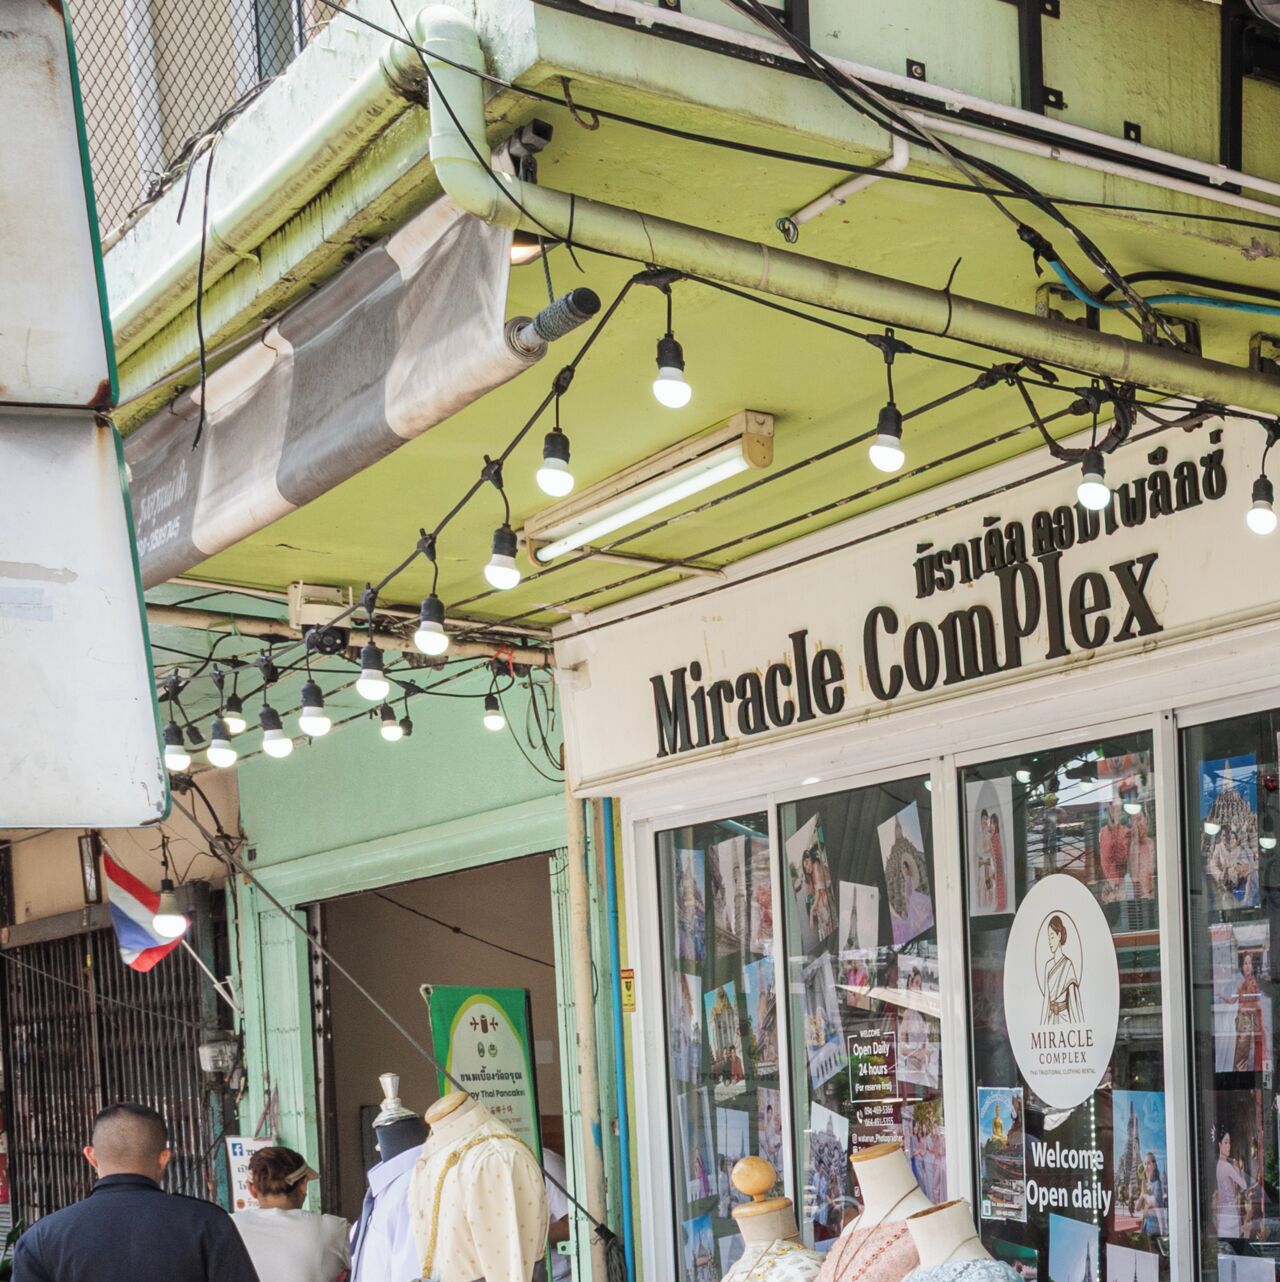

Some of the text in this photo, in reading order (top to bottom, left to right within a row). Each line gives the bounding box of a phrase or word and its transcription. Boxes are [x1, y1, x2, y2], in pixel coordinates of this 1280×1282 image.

[912, 516, 1029, 599] มิราเคิล
[649, 629, 847, 758] Miracle
[853, 1041, 890, 1059] Open Daily
[1031, 1029, 1094, 1050] MIRACLE
[1039, 1051, 1087, 1065] COMPLEX
[858, 1062, 888, 1076] 24 hours
[481, 1090, 495, 1098] Thai
[1031, 1141, 1104, 1170] Welcome
[1026, 1179, 1112, 1217] Open daily
